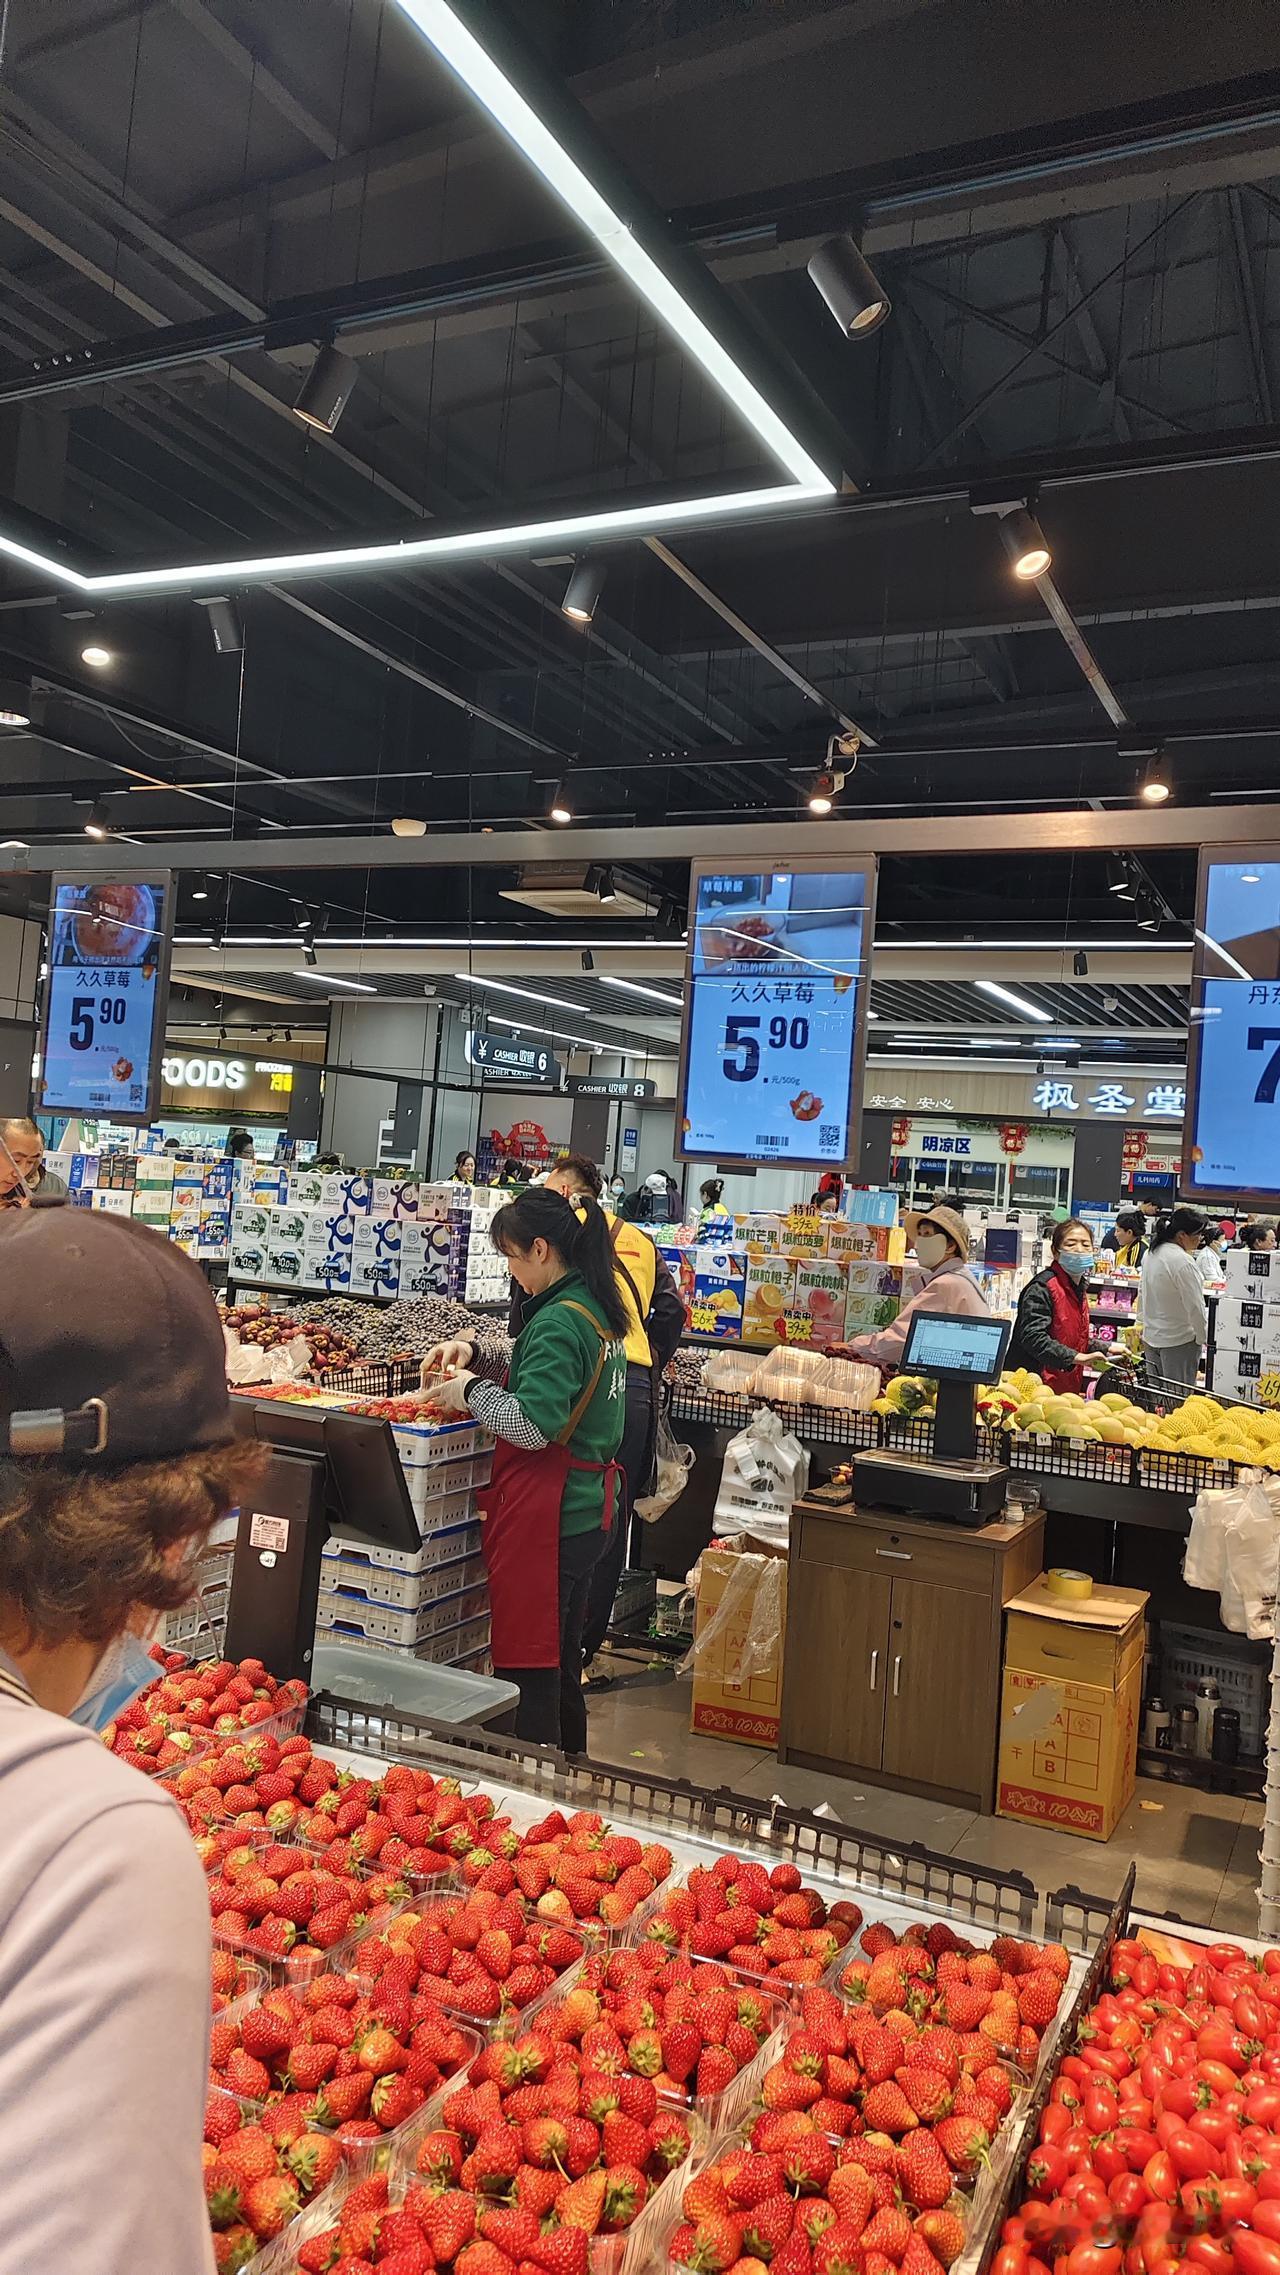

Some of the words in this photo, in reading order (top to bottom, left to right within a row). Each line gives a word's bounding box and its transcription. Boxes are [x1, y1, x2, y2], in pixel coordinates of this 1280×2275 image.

[76, 971, 131, 988] 久久草莓
[731, 981, 815, 1003] 久久草莓
[493, 1050, 518, 1061] CASHIER
[519, 1049, 535, 1064] 收银
[538, 1052, 547, 1070] 6
[1247, 1027, 1280, 1104] 7
[771, 1075, 801, 1085] 元/500g
[577, 1085, 607, 1093] CASHIER
[608, 1083, 629, 1094] 收银
[633, 1084, 645, 1097] 8
[869, 1094, 907, 1109] 安全
[916, 1096, 955, 1111] 安心
[1032, 1080, 1186, 1117] 枫圣堂
[922, 1135, 971, 1155] 阴凉区
[793, 1203, 816, 1216] 特价
[792, 1218, 814, 1230] 39元
[735, 1228, 778, 1244] 爆粒芒果
[830, 1236, 875, 1252] 爆粒橙子
[749, 1268, 794, 1285] 爆粒橙子
[799, 1272, 845, 1290] 爆粒桃桃
[690, 1299, 716, 1311] 热卖中
[692, 1312, 714, 1325] 56元
[783, 1309, 812, 1320] 热卖中
[787, 1321, 808, 1335] 39元
[1044, 1760, 1056, 1773] B
